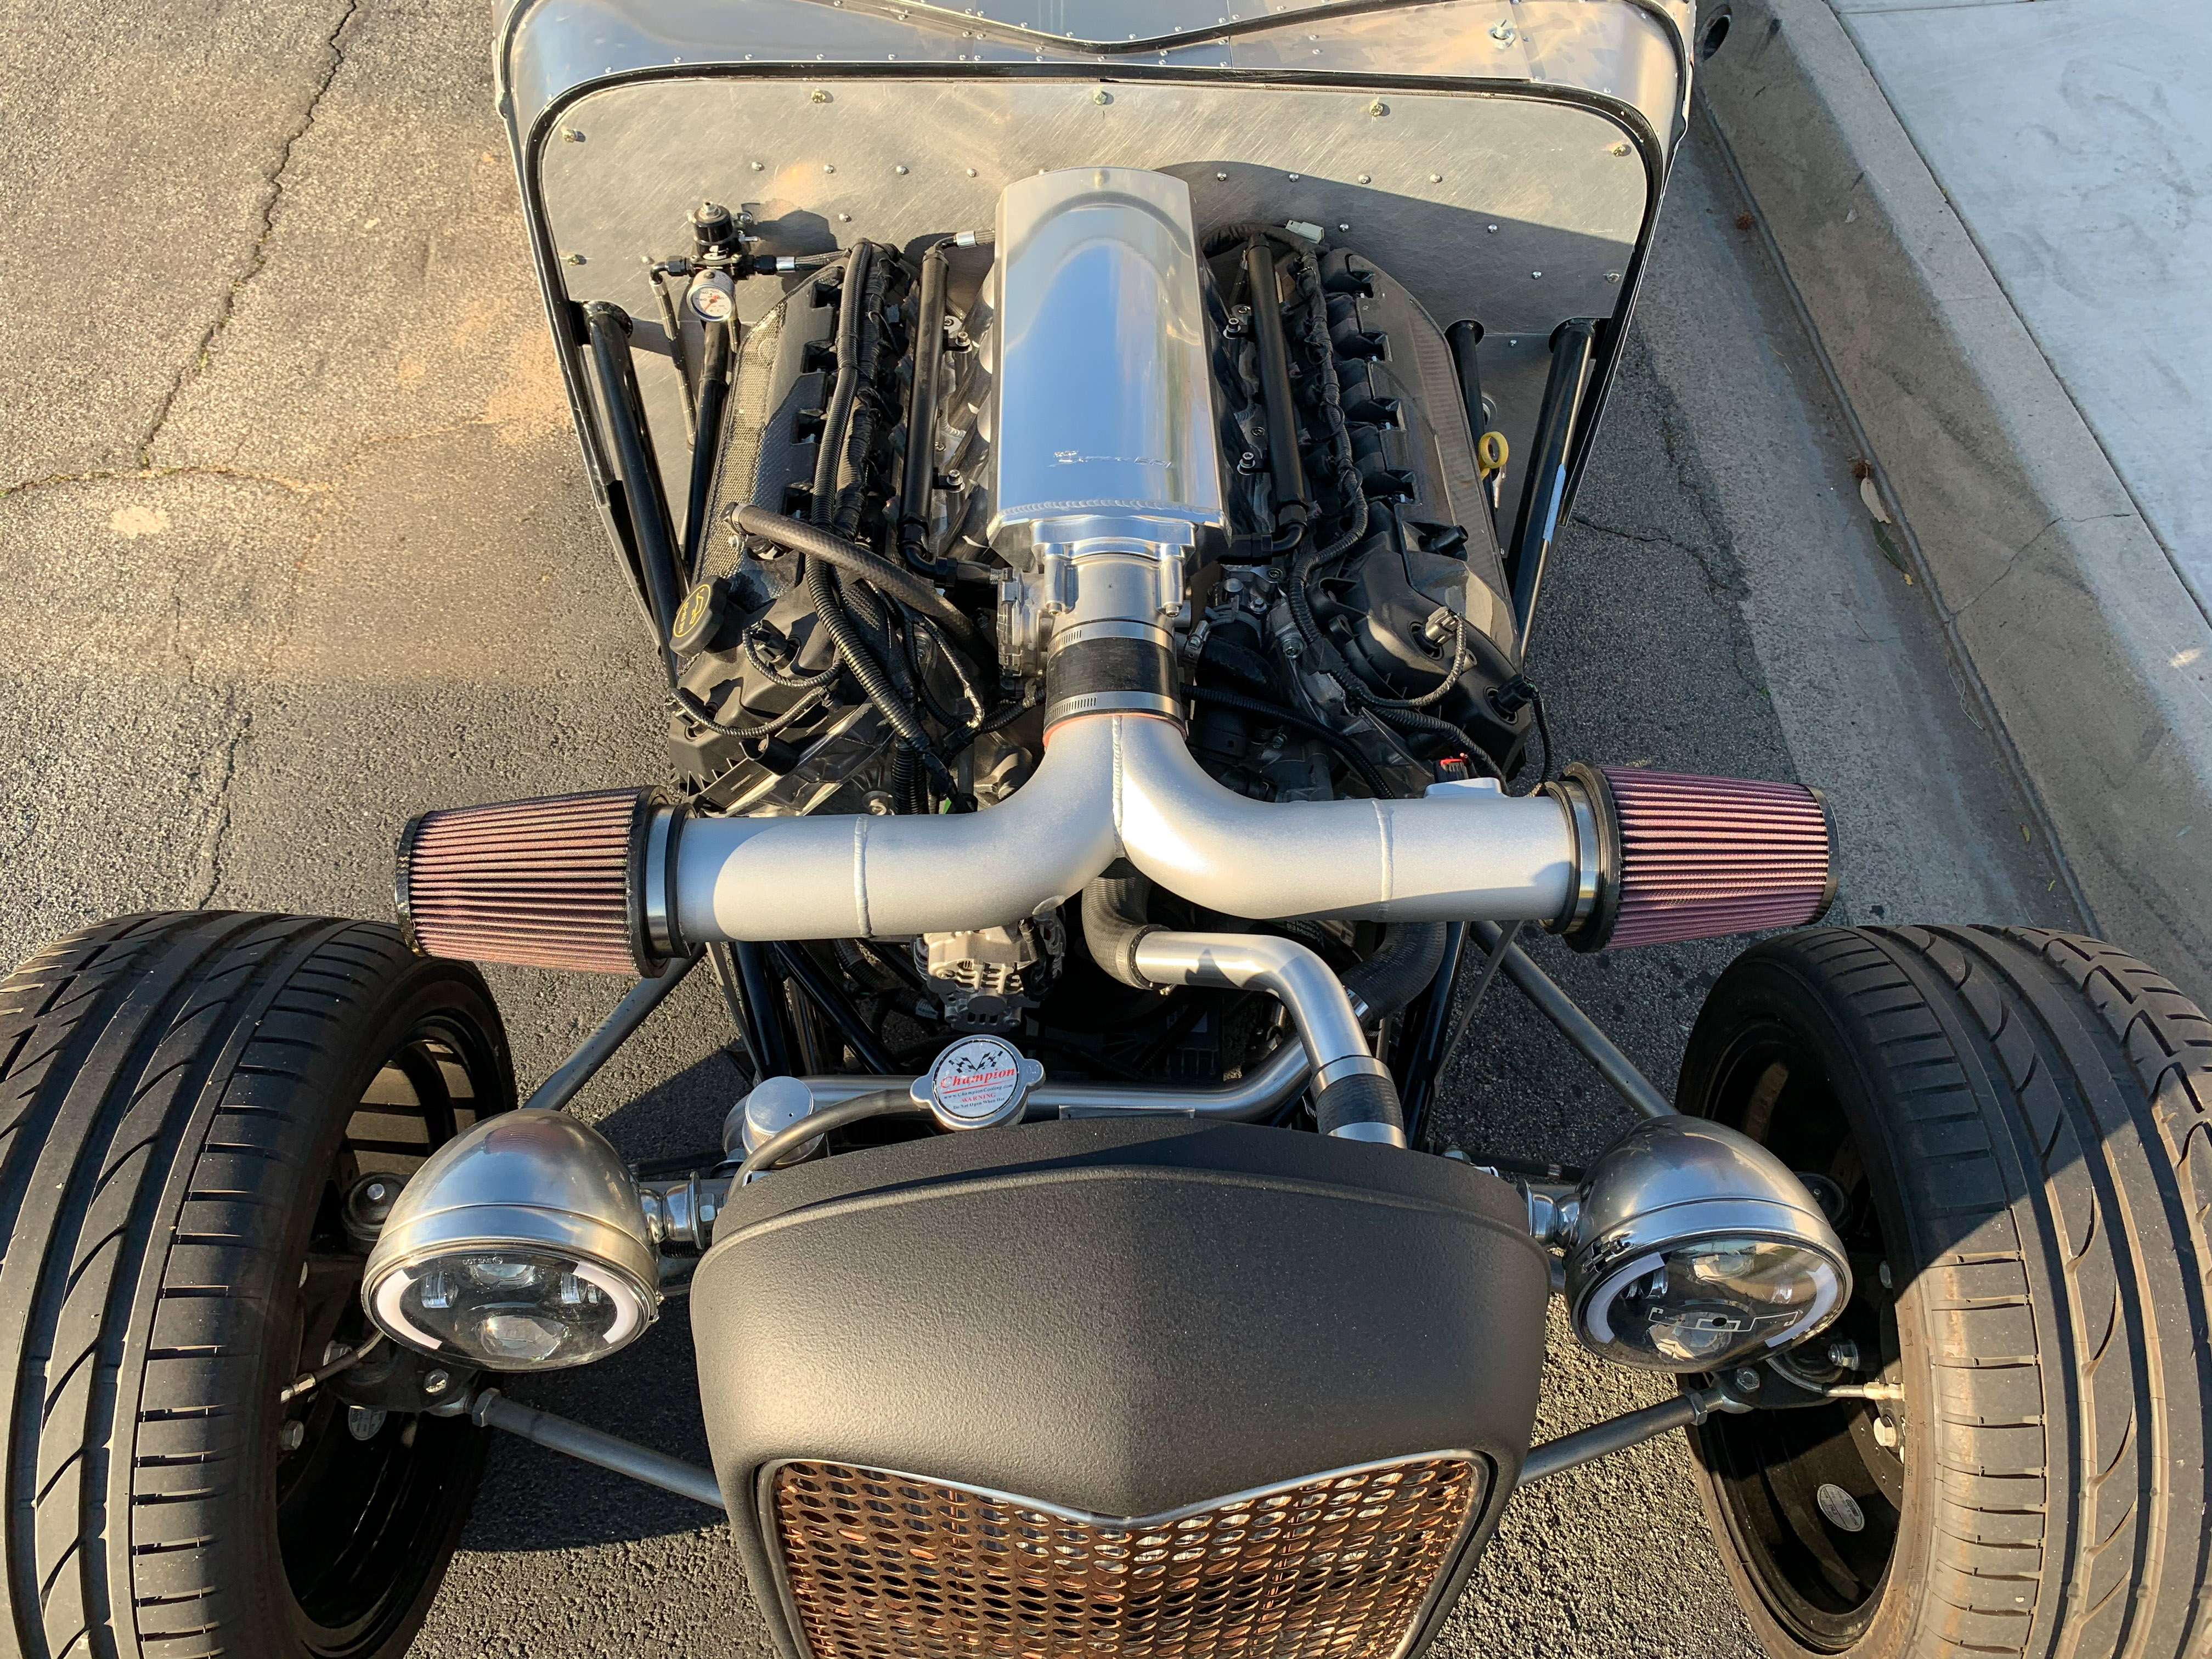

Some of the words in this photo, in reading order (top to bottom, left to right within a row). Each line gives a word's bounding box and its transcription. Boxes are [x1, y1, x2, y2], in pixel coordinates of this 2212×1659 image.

[940, 1068, 1015, 1088] Champion
[944, 1084, 1013, 1099] www.ChampionCooling.com
[961, 1092, 996, 1103] WARNING
